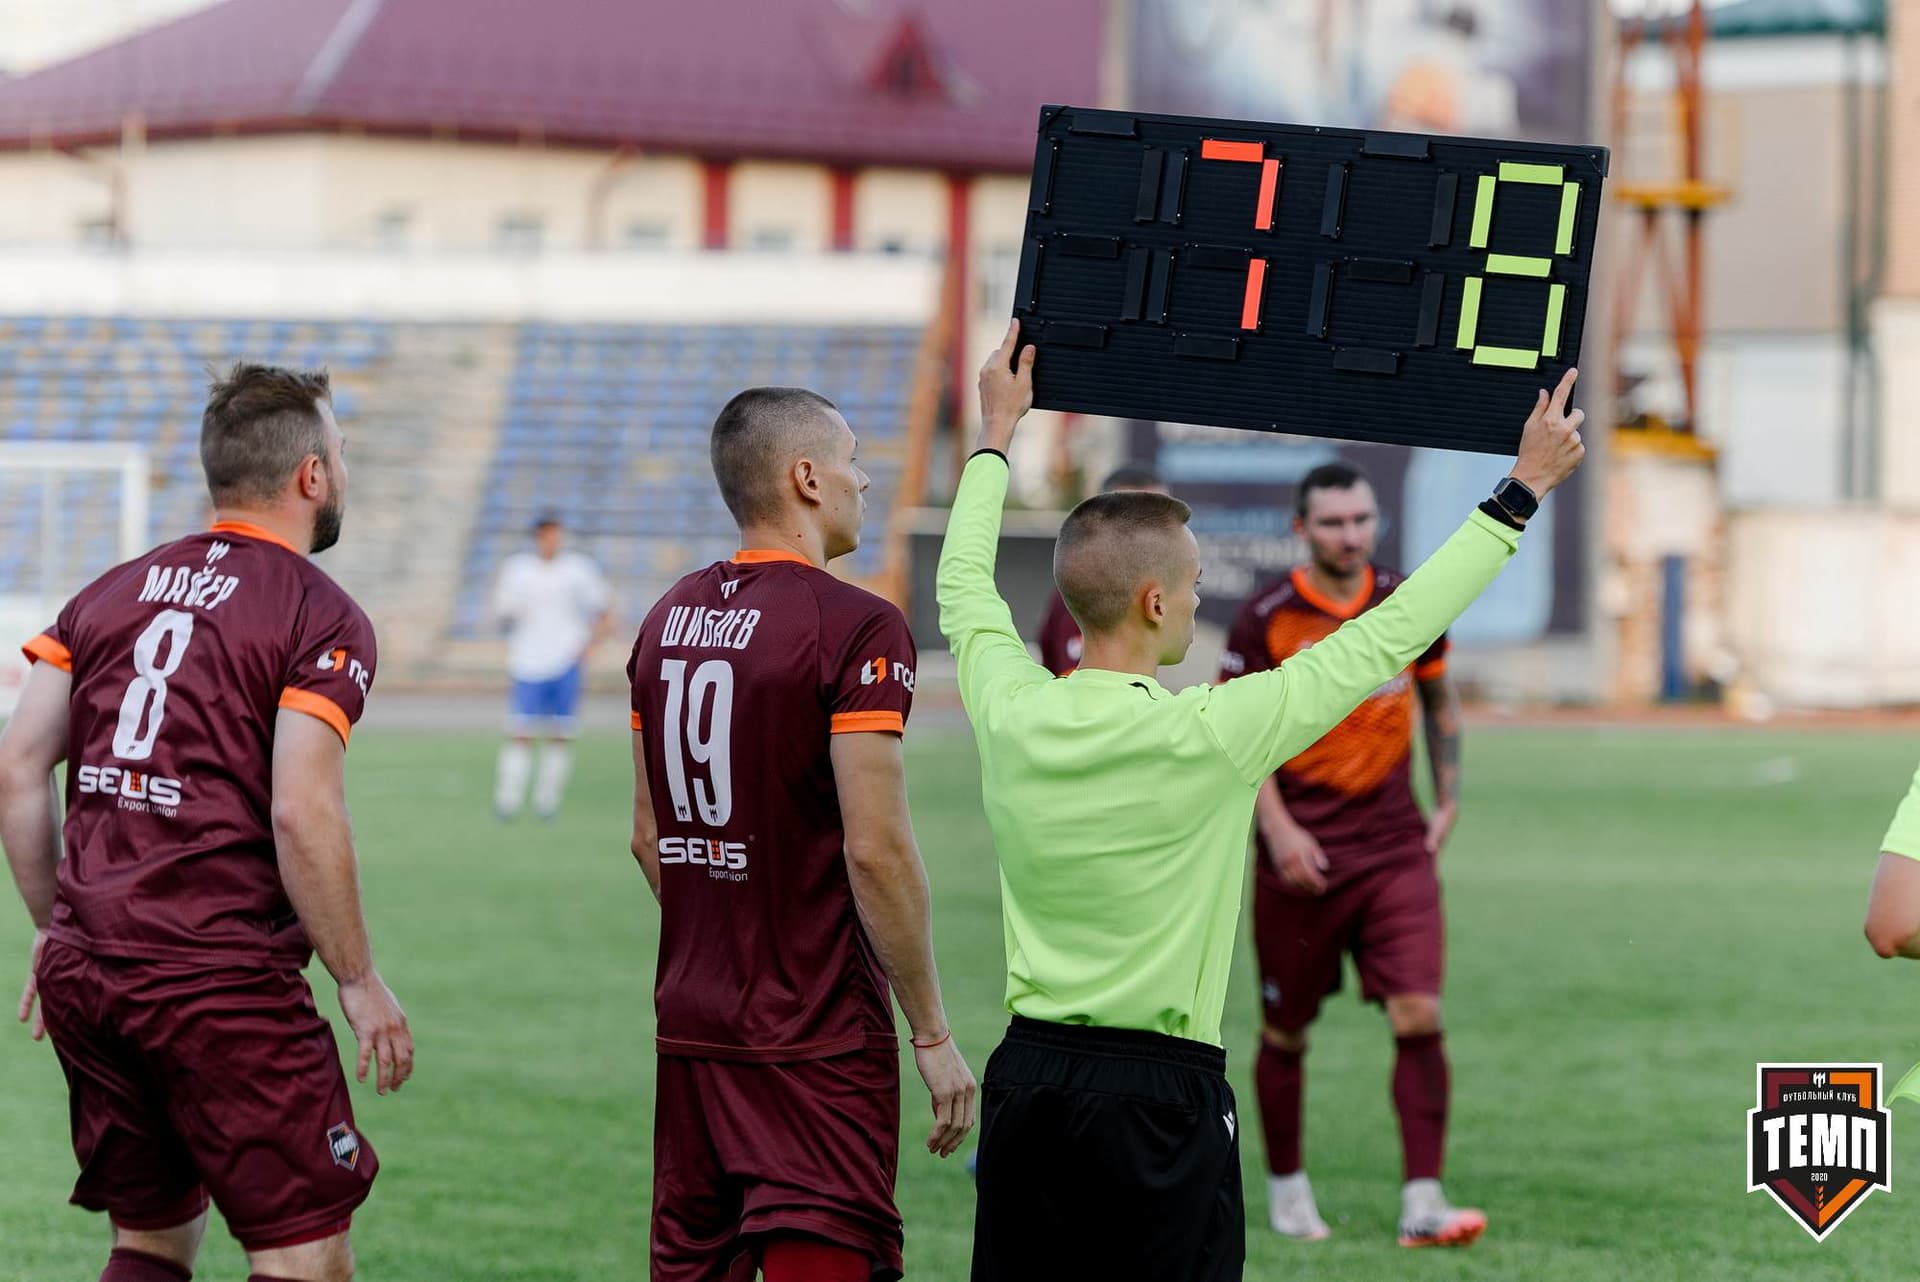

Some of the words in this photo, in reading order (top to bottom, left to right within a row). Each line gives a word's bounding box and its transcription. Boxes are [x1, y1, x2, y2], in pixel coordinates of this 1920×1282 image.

[1200, 138, 1281, 331] 7
[1455, 161, 1582, 371] 8
[137, 565, 240, 610] МАЙЕР
[660, 606, 761, 650] ШИБАЕВ
[112, 608, 195, 760] 8
[660, 658, 734, 827] 19
[78, 765, 182, 807] SEUS
[117, 796, 150, 813] Export
[658, 836, 748, 870] SEUS
[708, 866, 729, 881] Export
